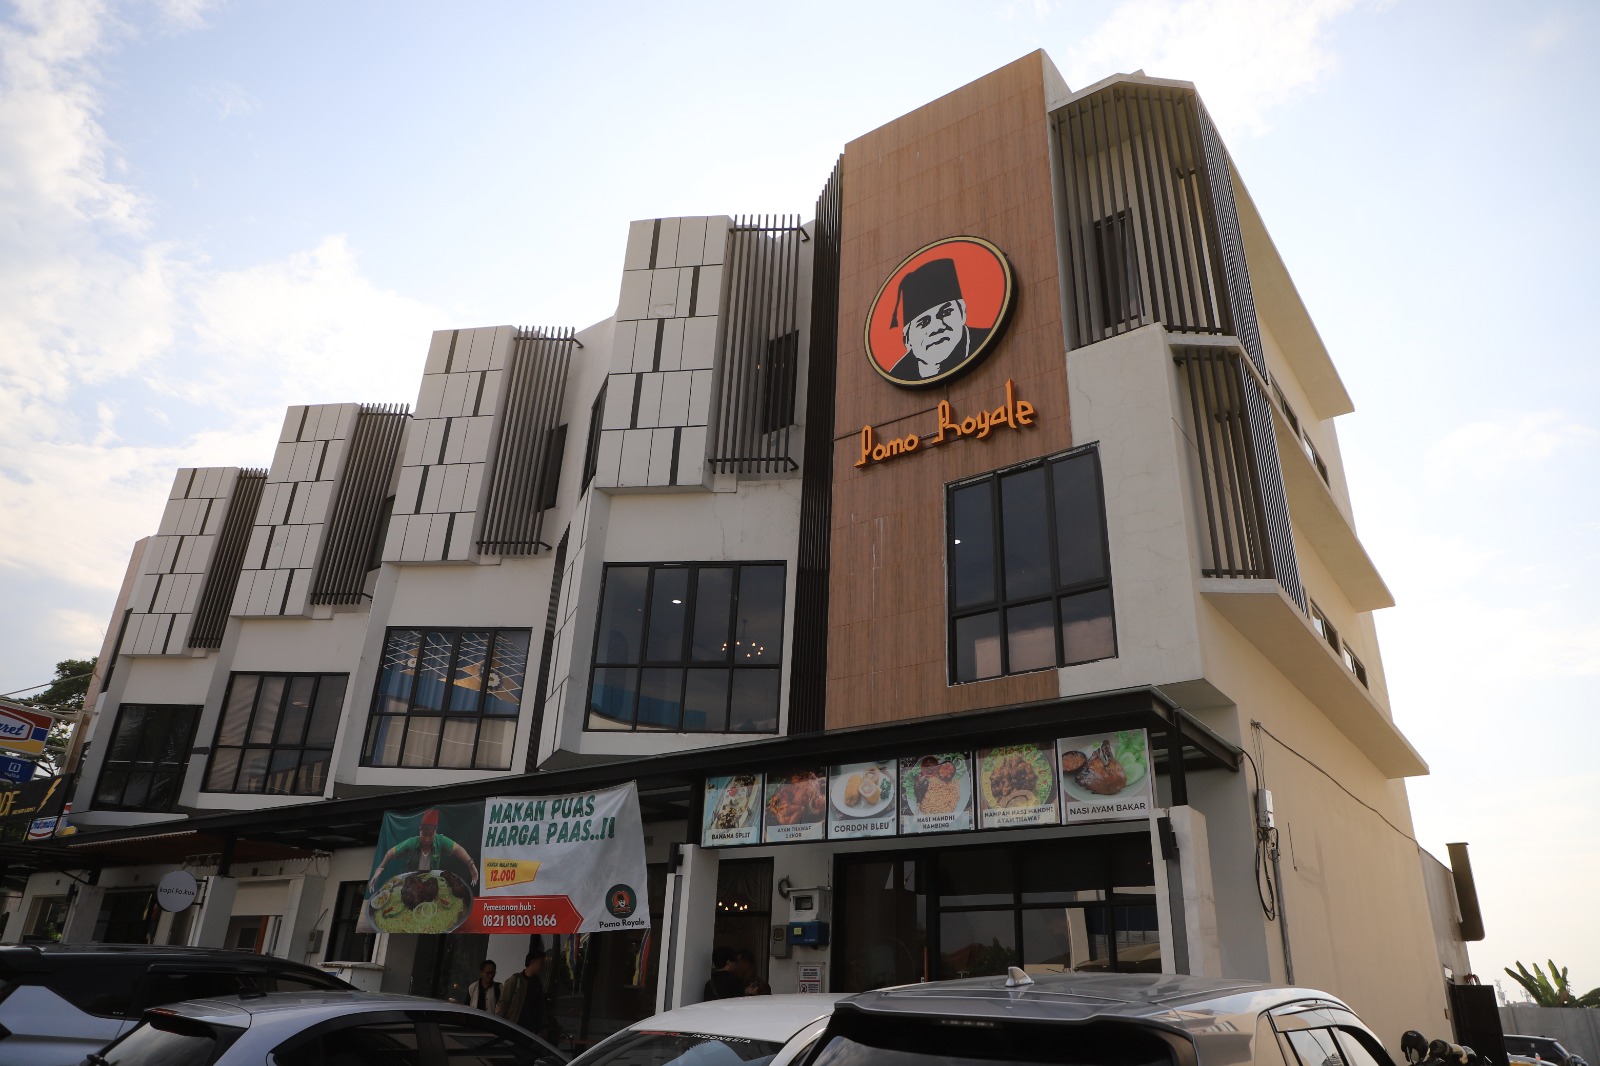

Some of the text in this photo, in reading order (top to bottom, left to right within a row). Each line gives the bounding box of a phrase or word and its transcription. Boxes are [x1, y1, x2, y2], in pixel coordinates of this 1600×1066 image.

[854, 379, 1037, 469] Pomo Royale
[489, 795, 595, 825] MAKAN PUAS
[1069, 802, 1146, 815] NASI AYAM BAKAR
[932, 814, 955, 822] MANDHI
[834, 822, 890, 833] CORDON BLEU
[485, 824, 540, 848] HARGA
[735, 831, 751, 839] SPLIT
[490, 869, 516, 882] 12.000
[159, 886, 175, 895] kopi
[483, 903, 518, 911] Pemesanan
[519, 902, 532, 911] hub
[482, 913, 557, 926] 0821 1800 1866
[599, 918, 645, 929] Pomo Royale
[691, 1032, 751, 1044] INDONESIA
